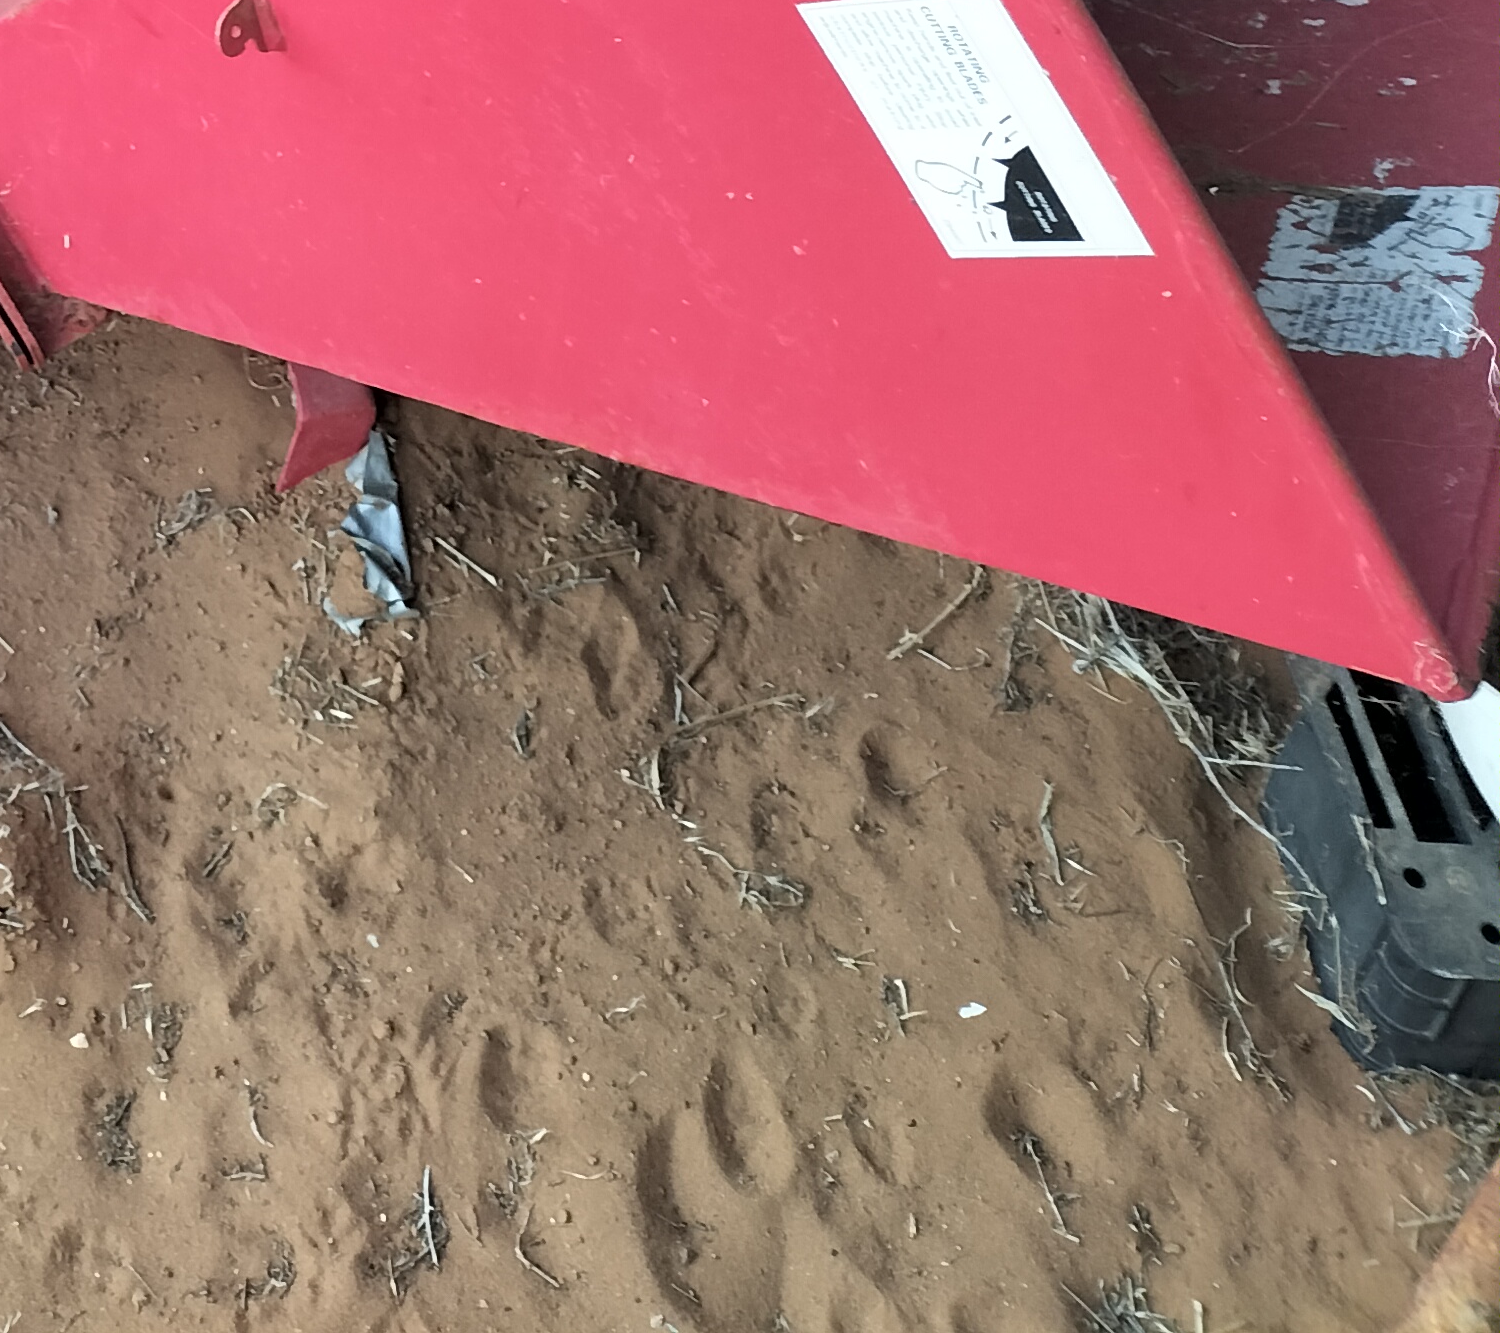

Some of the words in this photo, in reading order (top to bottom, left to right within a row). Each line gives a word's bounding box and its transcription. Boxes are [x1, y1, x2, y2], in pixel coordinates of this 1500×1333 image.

[920, 6, 954, 55] CUTTING
[955, 61, 987, 104] BLADES
[949, 25, 989, 83] ROTATING
